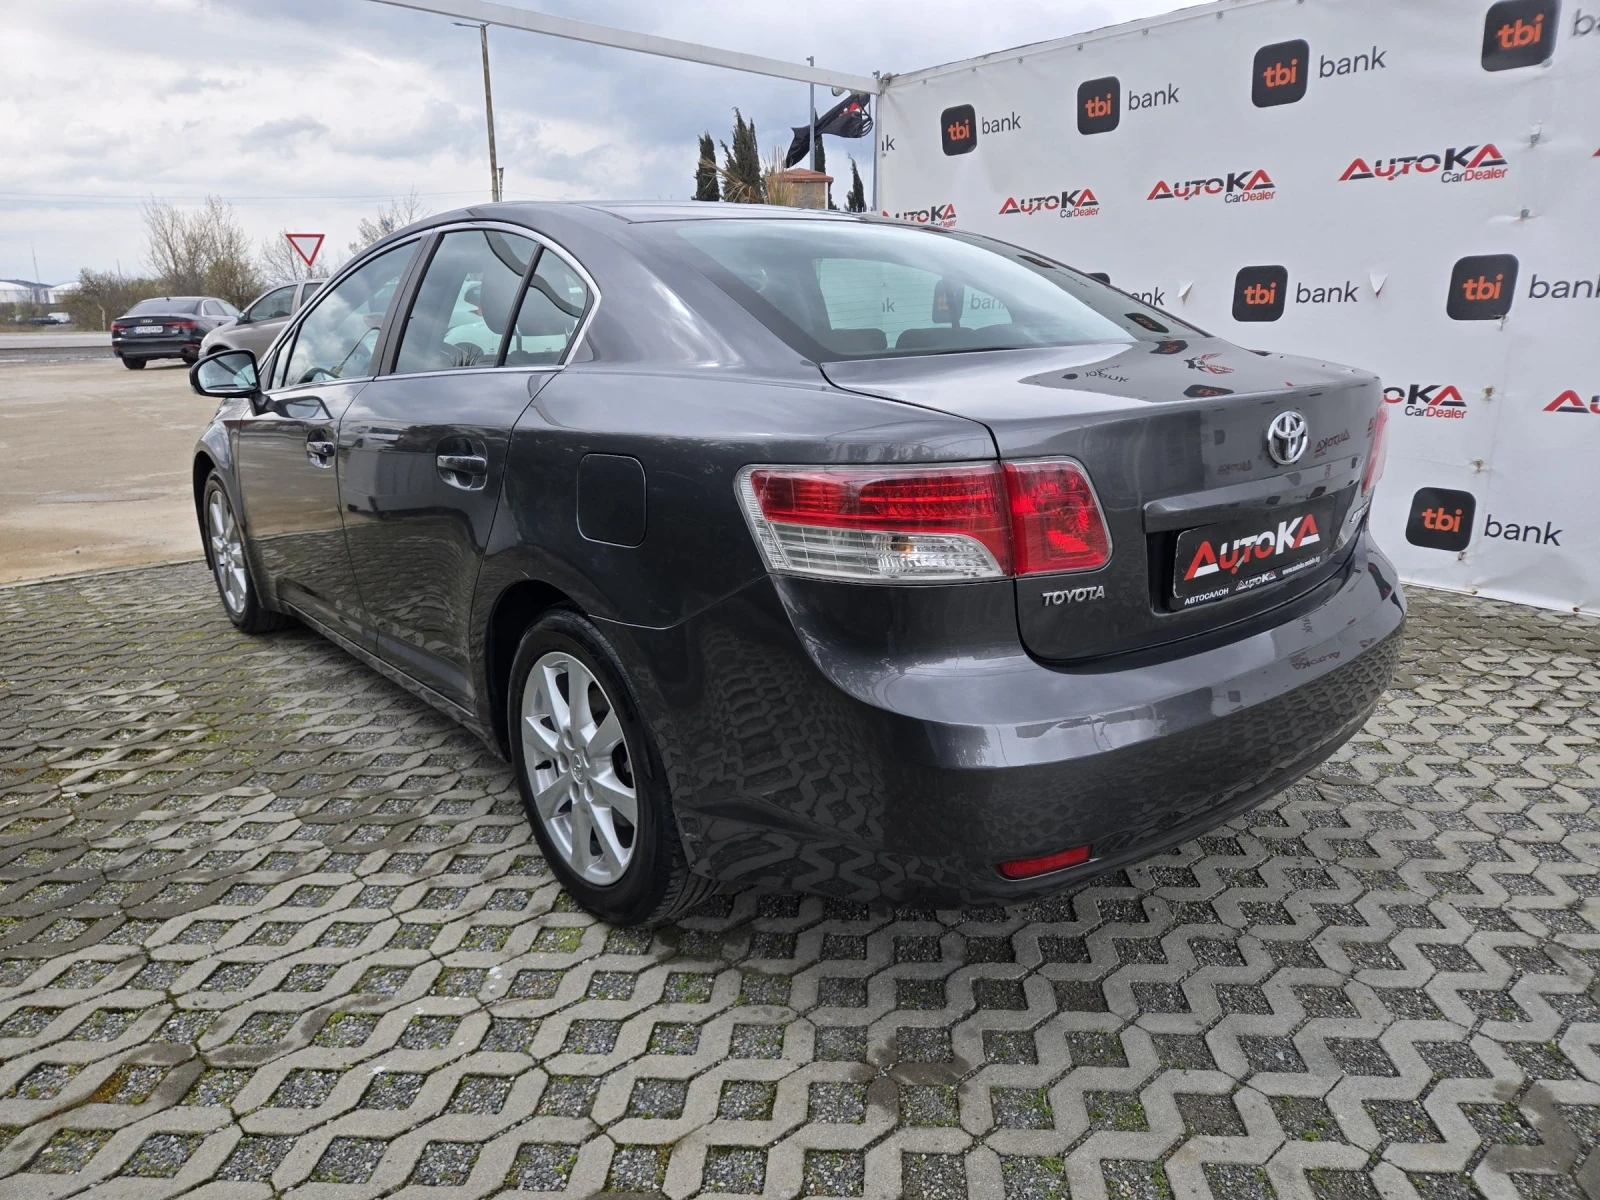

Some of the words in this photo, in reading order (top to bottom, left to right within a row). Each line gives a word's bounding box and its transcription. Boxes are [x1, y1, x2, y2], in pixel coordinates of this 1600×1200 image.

[1497, 13, 1544, 49] tbi
[1263, 59, 1297, 87] tbi
[1319, 46, 1387, 78] bank
[1085, 94, 1112, 118] tbi
[1128, 83, 1180, 111] bank
[948, 120, 970, 140] tbi
[982, 112, 1021, 135] bank
[1244, 282, 1277, 304] tbi
[1295, 281, 1360, 303] bank
[1462, 274, 1503, 300] tbi
[1528, 274, 1600, 299] ban
[1405, 405, 1467, 419] CarDealer
[1421, 507, 1463, 533] tbi
[1484, 514, 1564, 546] bank
[1184, 513, 1321, 581] AUTOKA
[1042, 585, 1105, 607] TOYOTA
[1184, 587, 1229, 606] АВТОСАЛОН
